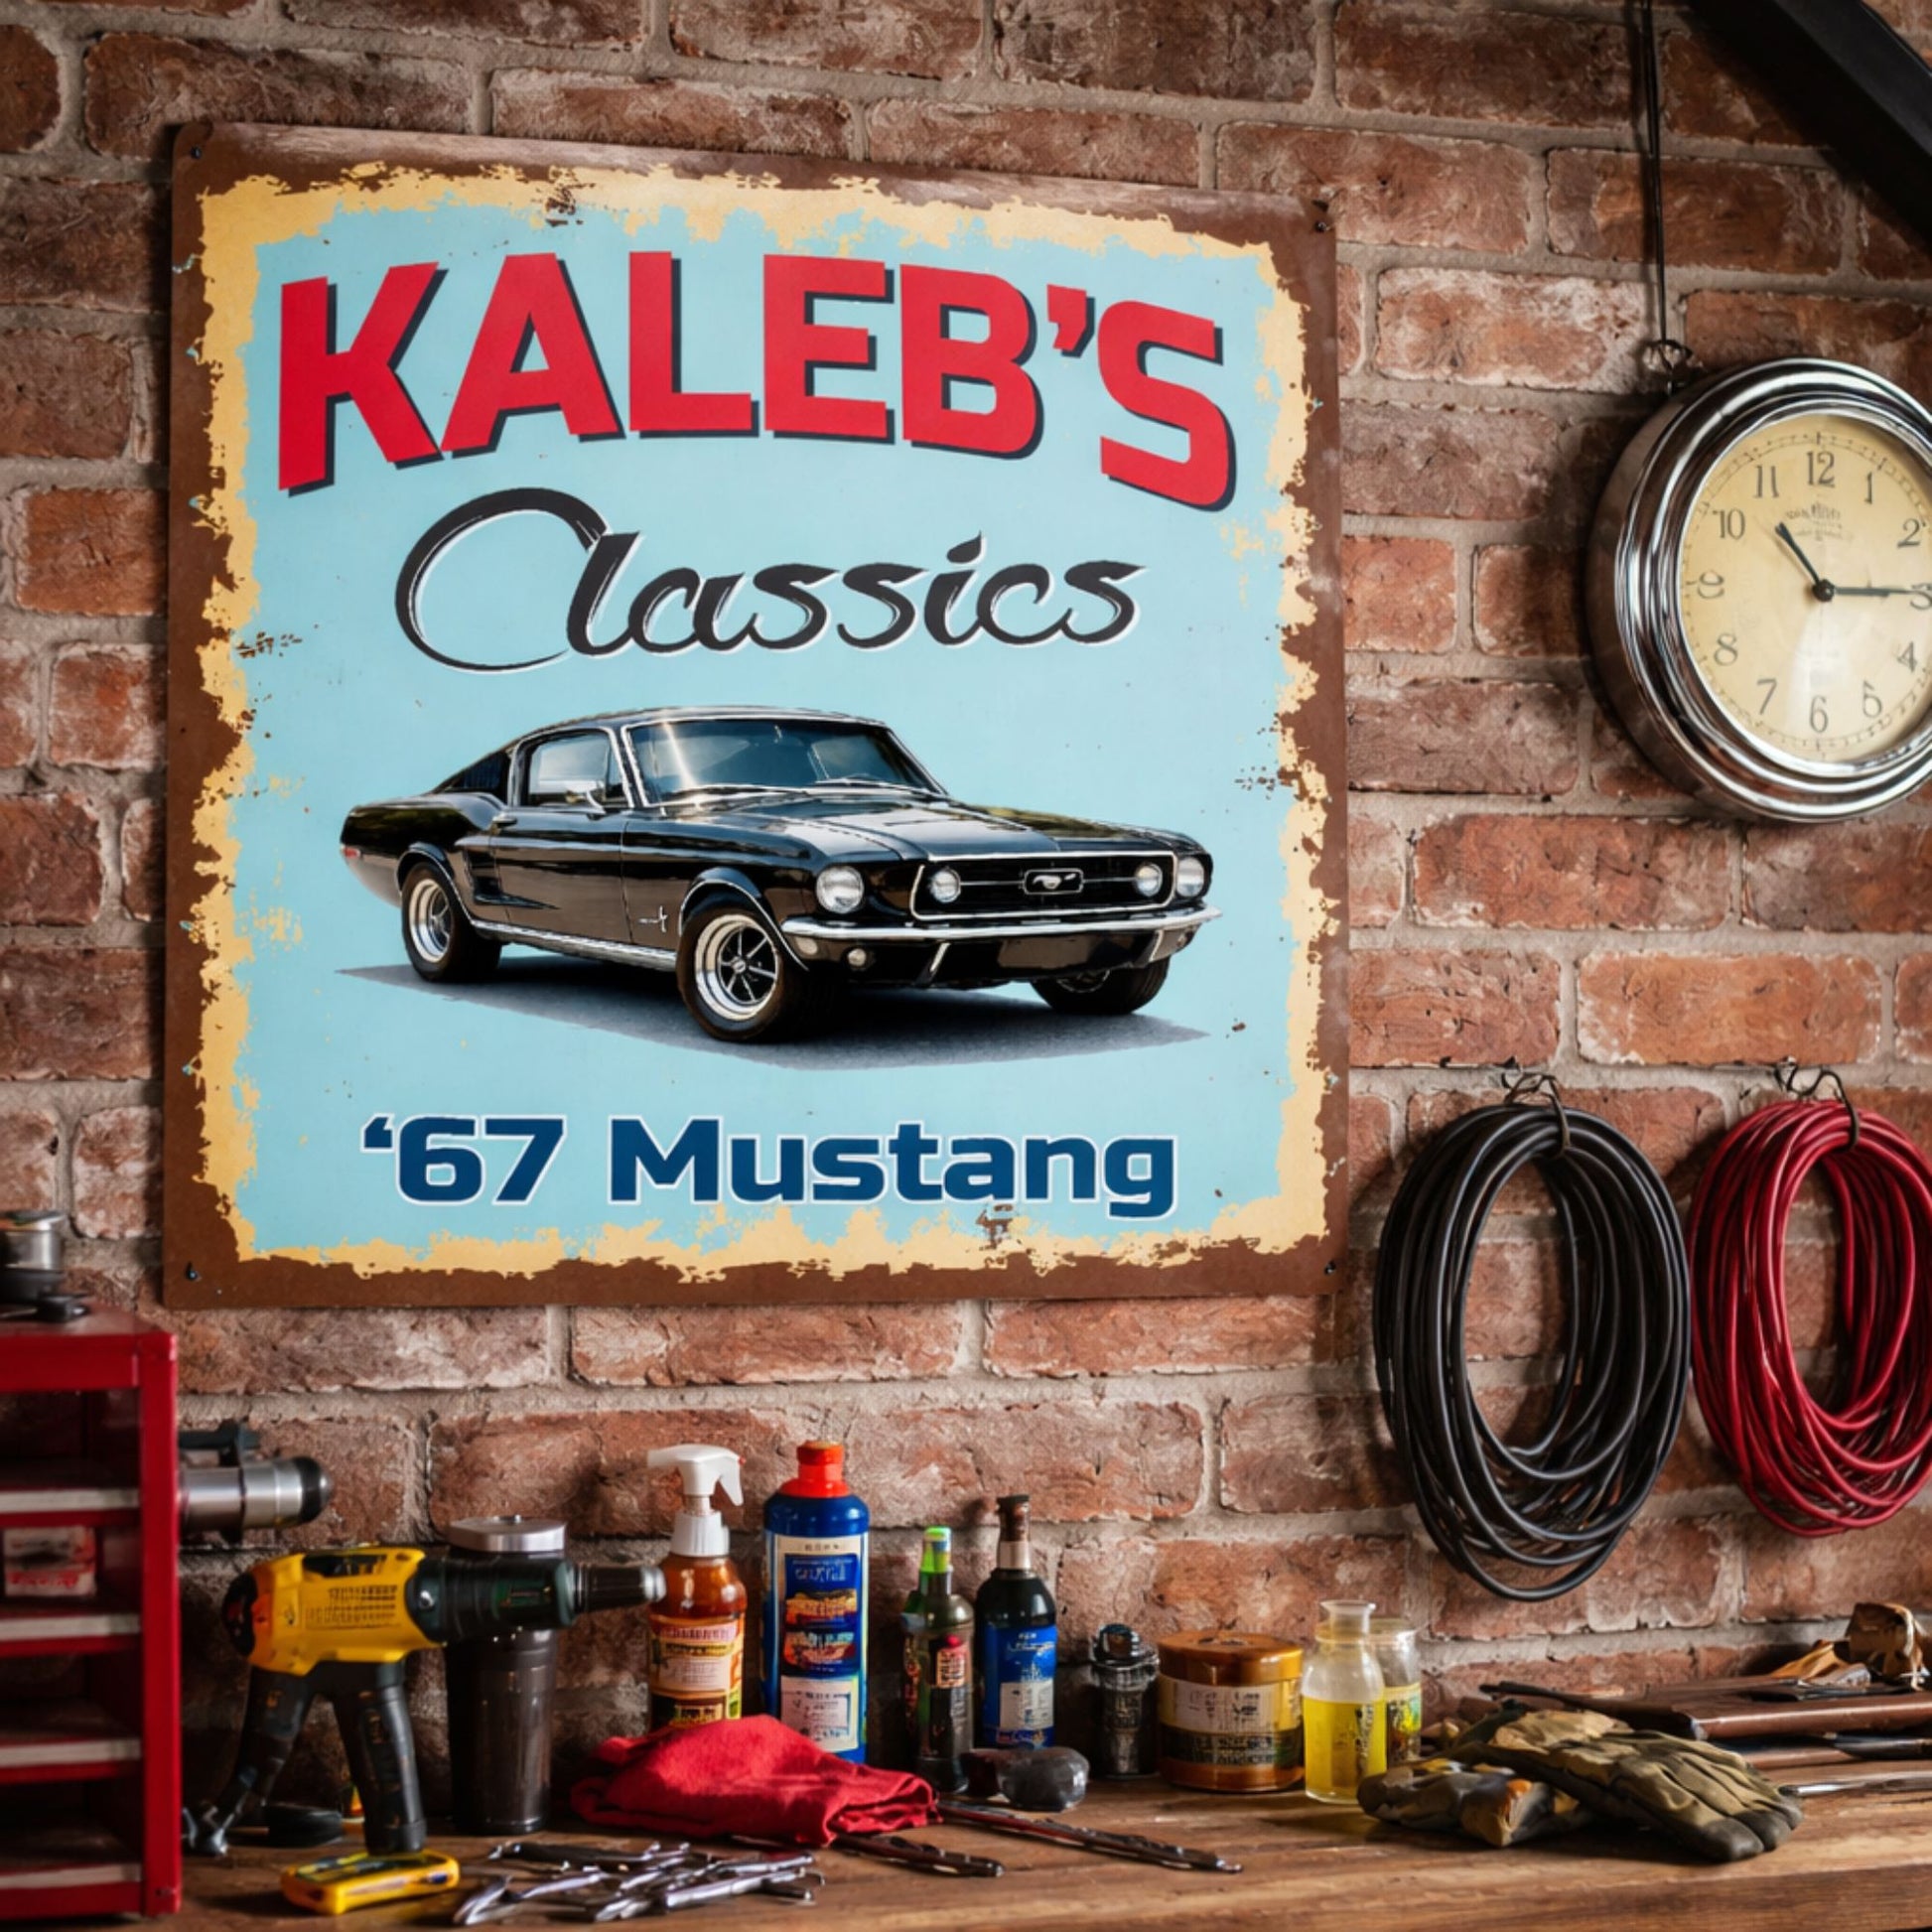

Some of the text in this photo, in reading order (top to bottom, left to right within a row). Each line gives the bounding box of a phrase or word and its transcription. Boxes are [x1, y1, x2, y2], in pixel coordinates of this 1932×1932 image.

[279, 251, 1237, 512] KALEB'S
[1753, 465, 1780, 498] 11
[1806, 451, 1836, 488] 12
[1863, 471, 1874, 505] 1
[1712, 508, 1746, 540] 10
[1896, 517, 1922, 549] 2
[395, 486, 1148, 672] Classics
[1713, 632, 1738, 667] 8
[1896, 640, 1918, 674] 4
[1756, 677, 1778, 716] 7
[1809, 694, 1829, 734] 6
[361, 1113, 1177, 1220] '67 Mustang
